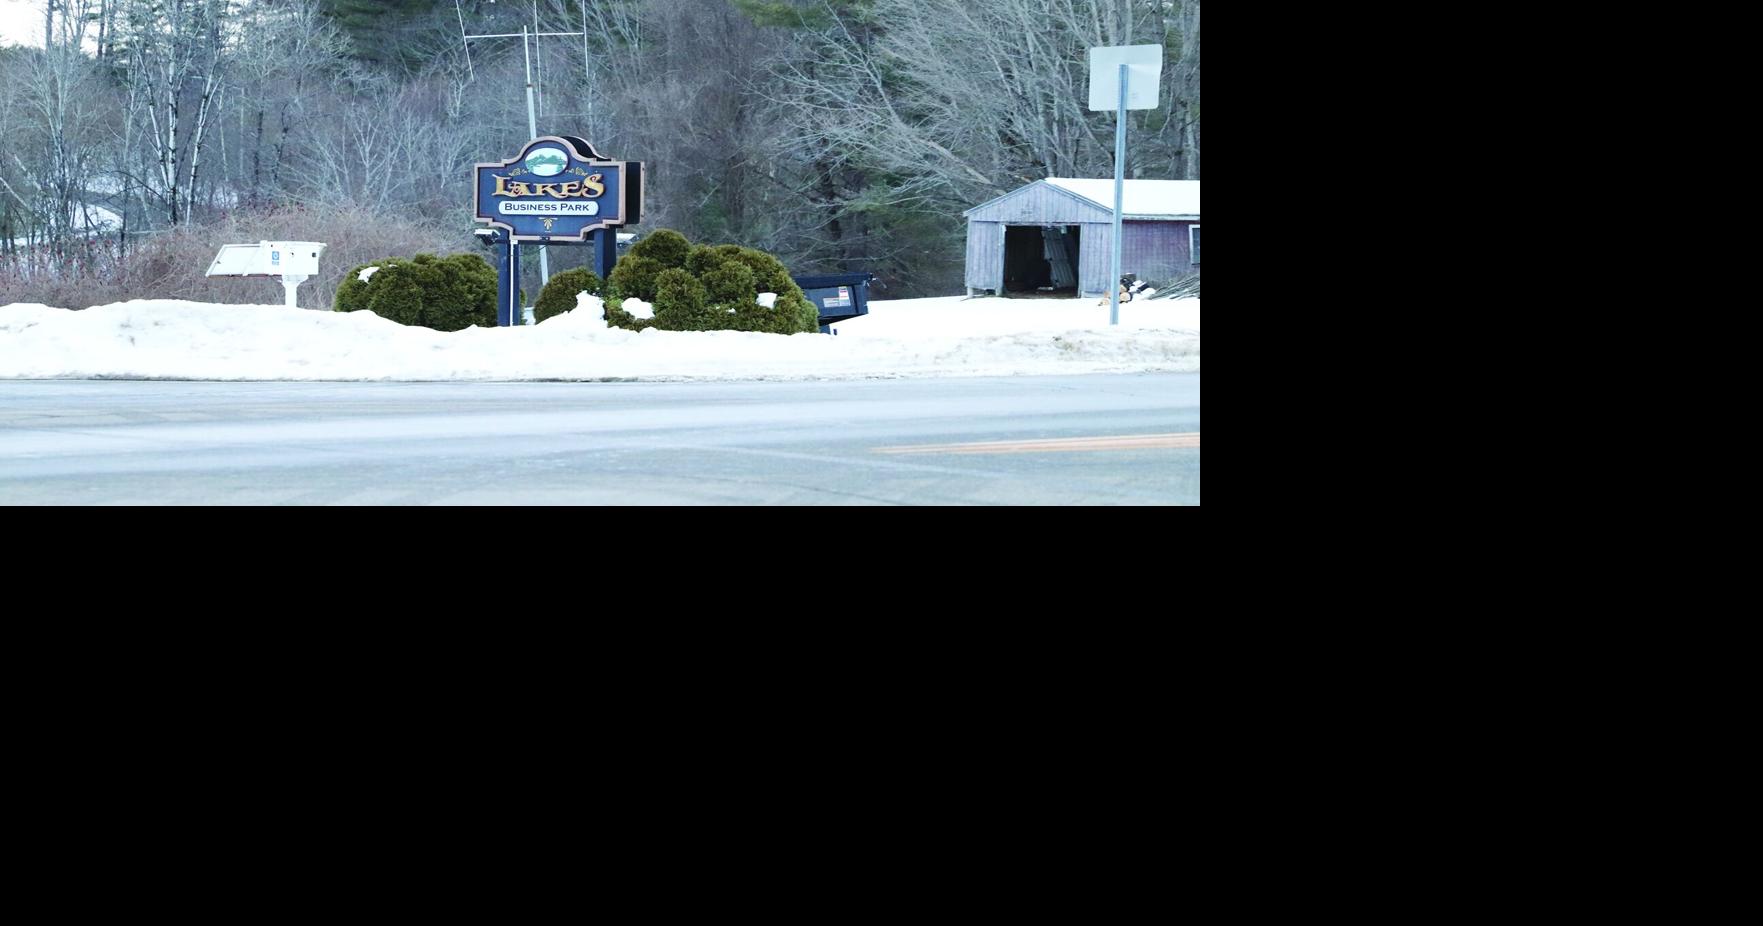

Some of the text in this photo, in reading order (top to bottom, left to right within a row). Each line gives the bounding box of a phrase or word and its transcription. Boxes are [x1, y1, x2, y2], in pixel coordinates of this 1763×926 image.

[492, 173, 605, 199] LAKES
[504, 203, 590, 212] BUSINESS PARK
